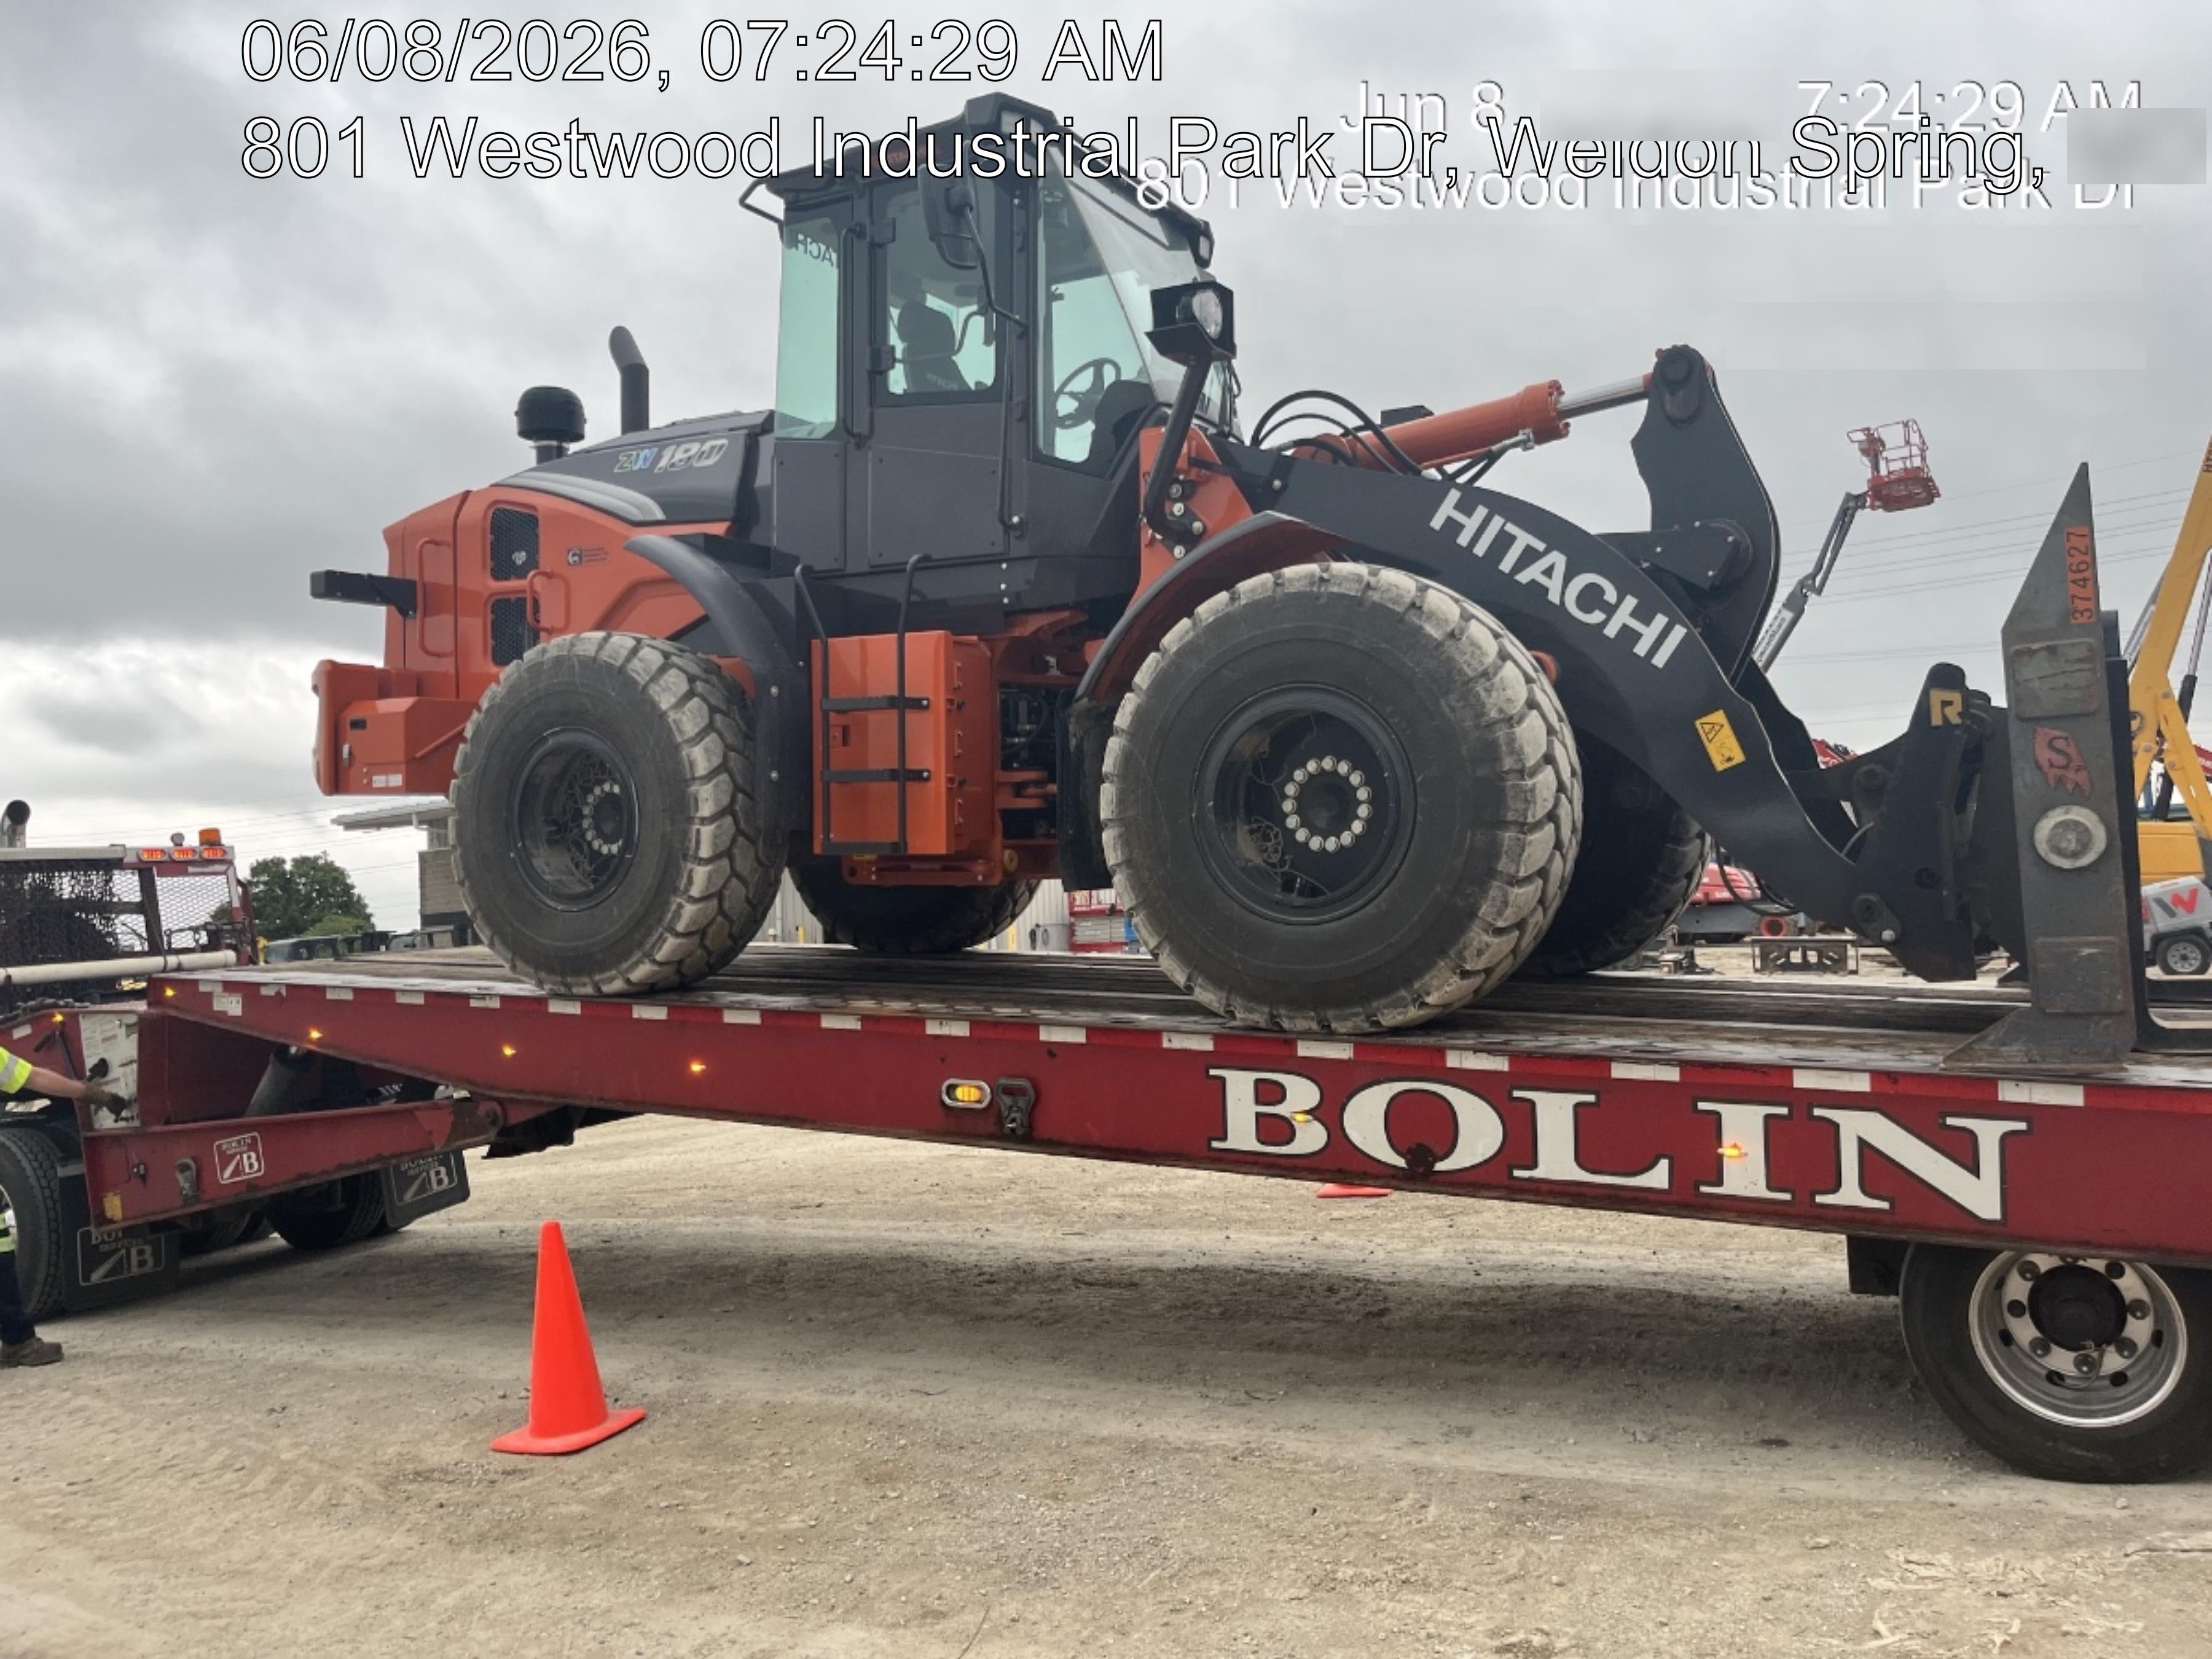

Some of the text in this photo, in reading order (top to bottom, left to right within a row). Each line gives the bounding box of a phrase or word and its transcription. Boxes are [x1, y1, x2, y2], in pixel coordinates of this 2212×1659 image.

[1429, 488, 1687, 669] HITACHI
[2066, 530, 2093, 621] 374627
[1929, 688, 1963, 727] R
[1207, 1066, 2030, 1223] BOLIN
